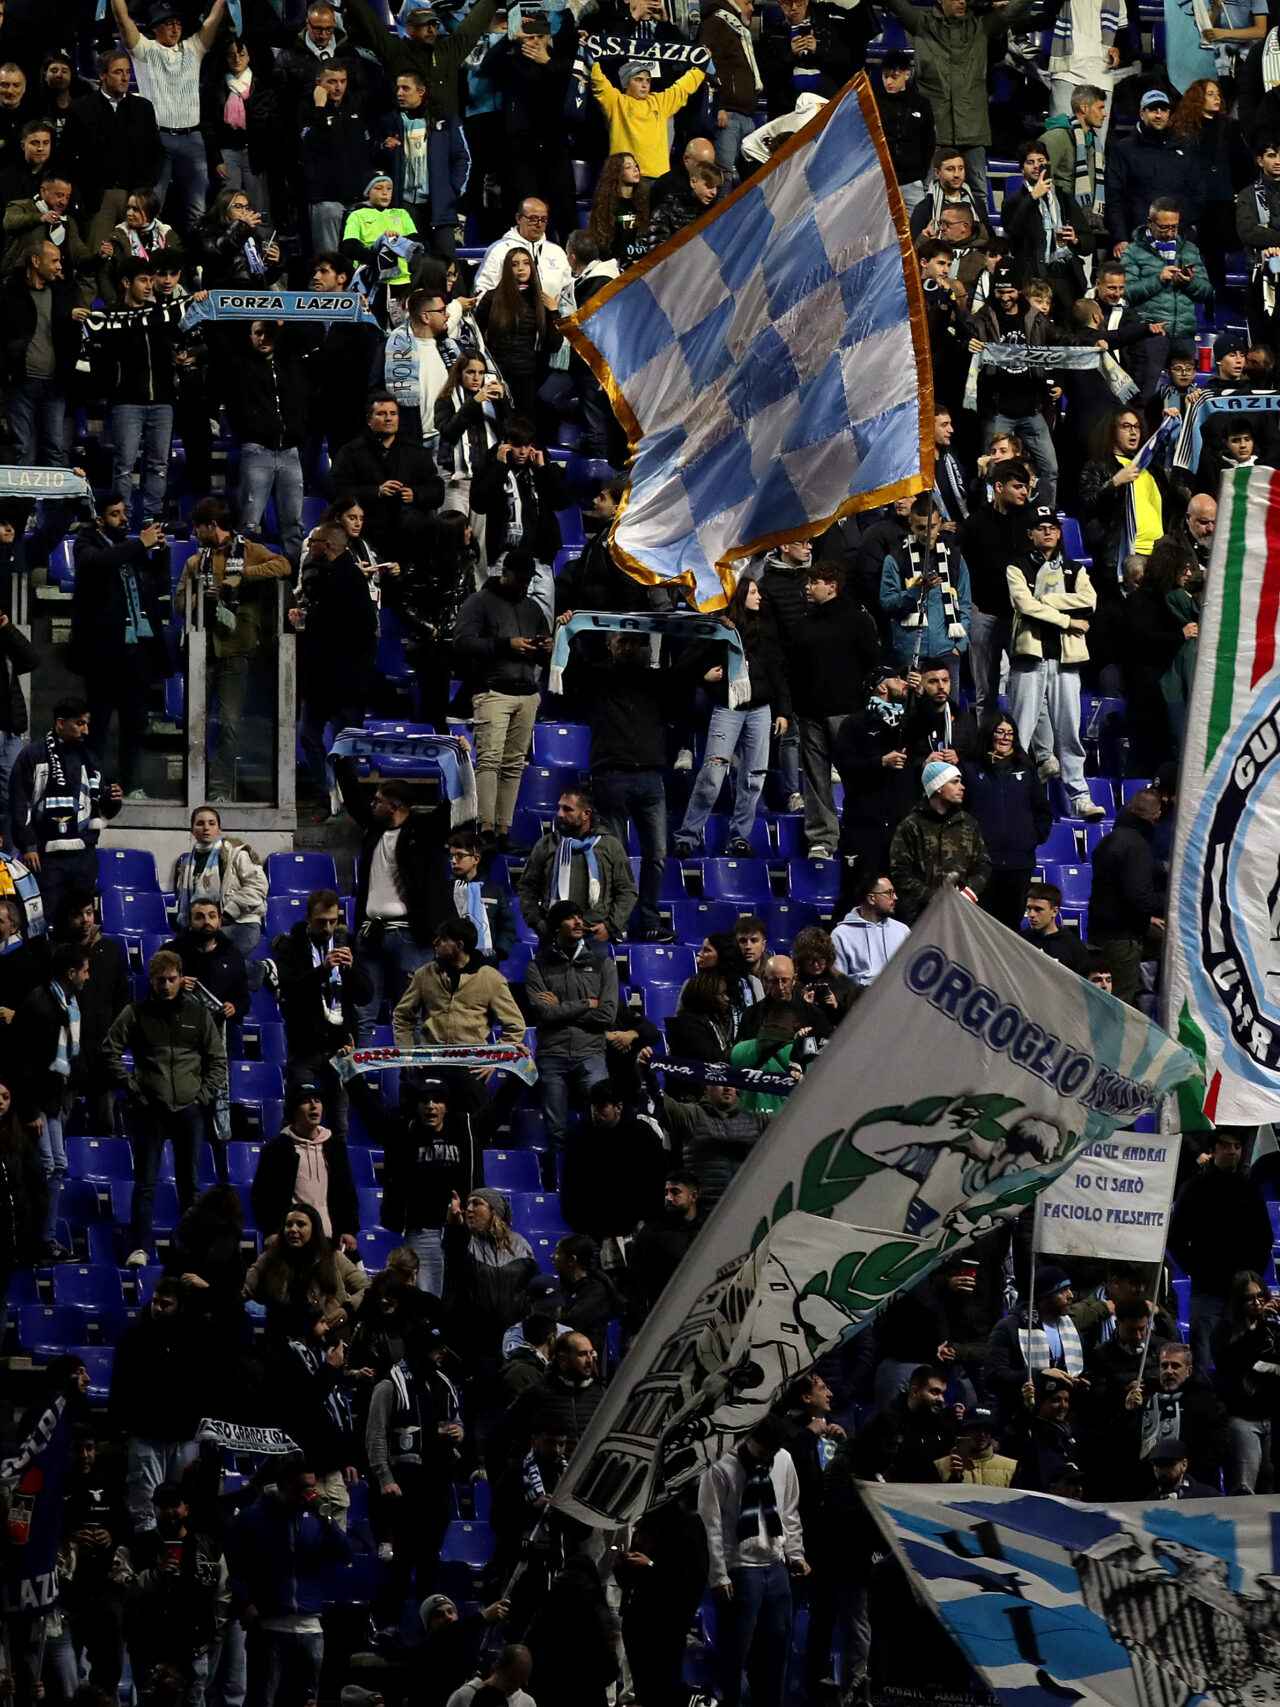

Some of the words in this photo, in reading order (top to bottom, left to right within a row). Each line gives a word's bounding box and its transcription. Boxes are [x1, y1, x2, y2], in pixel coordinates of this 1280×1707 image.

[219, 295, 285, 309] FORZA
[295, 296, 355, 310] LAZIO
[7, 471, 66, 488] LAZIO
[591, 616, 718, 636] LAZIO
[351, 740, 441, 761] LAZIO
[904, 945, 1095, 1100] ORGOGLIO
[1082, 1143, 1118, 1159] NQUE
[1122, 1145, 1168, 1163] ANDRAI
[1076, 1174, 1092, 1189] IO
[1096, 1176, 1108, 1191] CI
[1111, 1176, 1145, 1194] SARÒ
[1043, 1202, 1103, 1222] FACIOLO
[1106, 1208, 1164, 1227] PRESENTE
